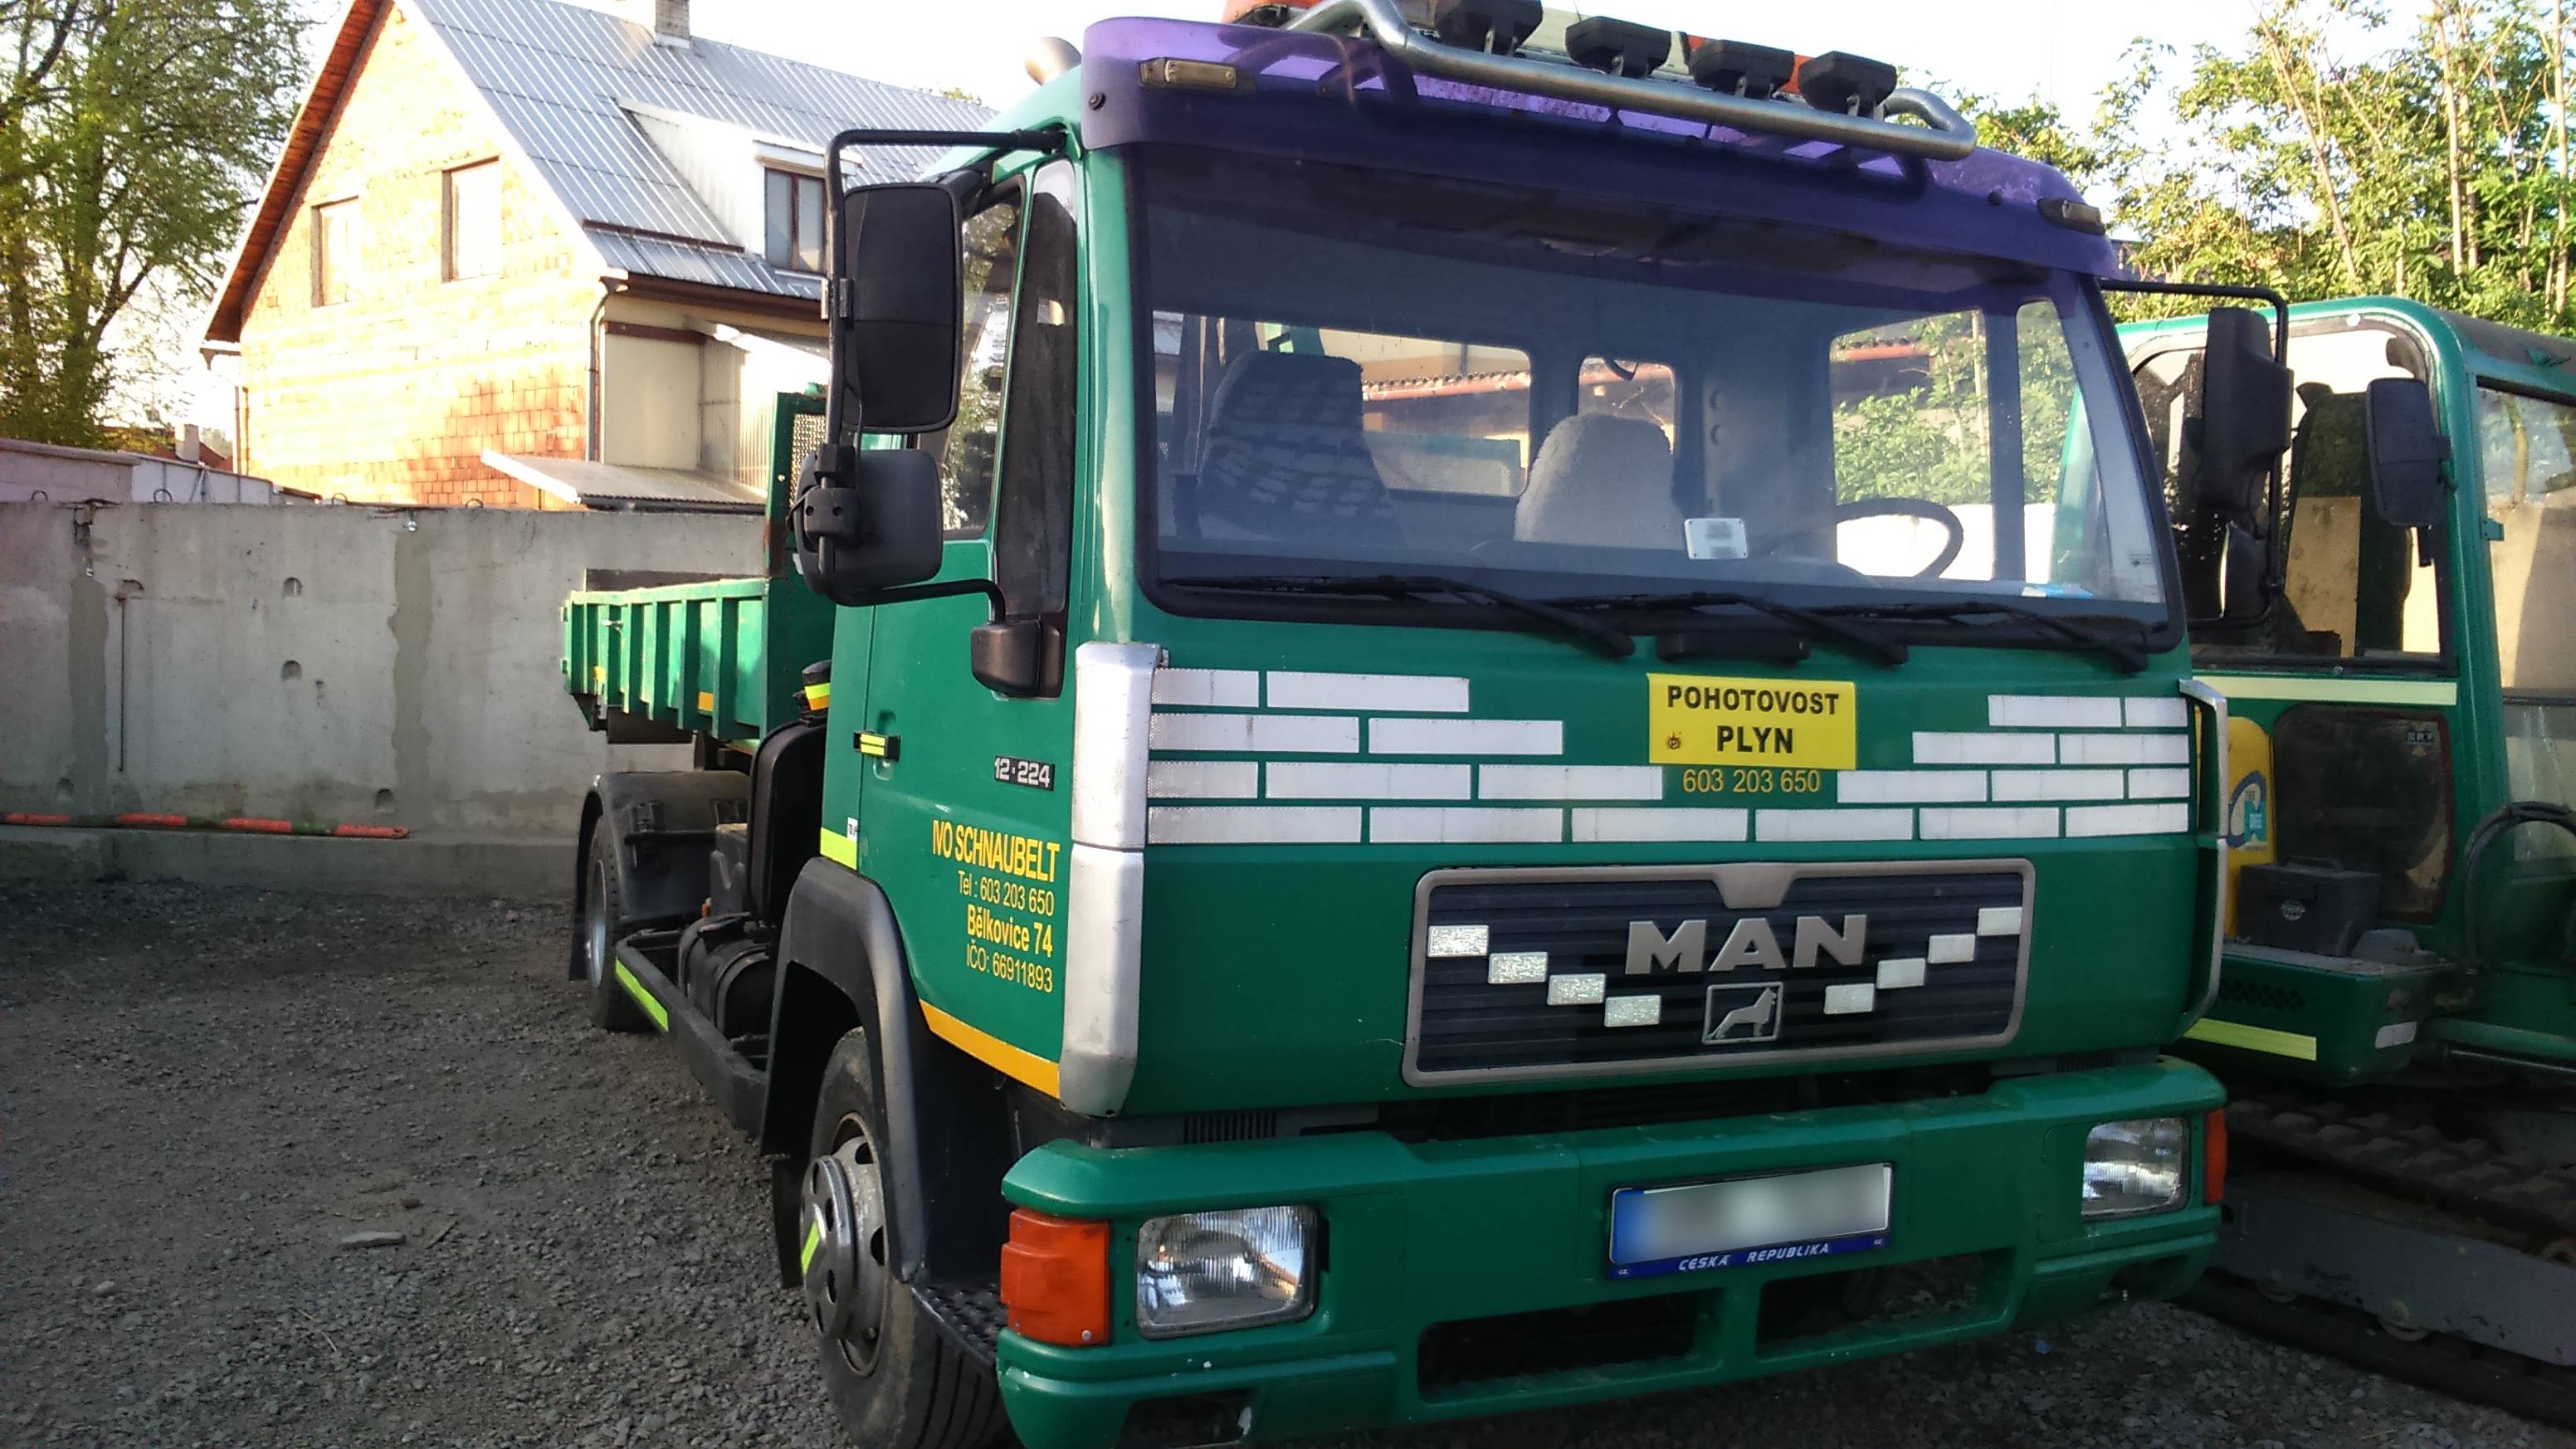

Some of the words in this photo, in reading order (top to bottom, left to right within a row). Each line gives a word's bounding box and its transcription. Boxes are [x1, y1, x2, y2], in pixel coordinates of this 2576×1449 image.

[1666, 685, 1840, 715] POHOTOVOST
[1716, 724, 1793, 754] PLYN
[1682, 768, 1725, 793] 603
[1732, 768, 1774, 793] 203
[1780, 768, 1821, 793] 650
[954, 824, 1061, 883] SCHNAUBELT
[980, 876, 1001, 905] 603
[1003, 881, 1026, 911] 203
[1028, 887, 1055, 917] 650
[967, 903, 1030, 953] Bělkovice
[1033, 921, 1053, 959] 74
[1625, 914, 1867, 975] MAN
[993, 952, 1053, 993] 66911893
[1745, 1242, 1830, 1263] REPUBLIKA
